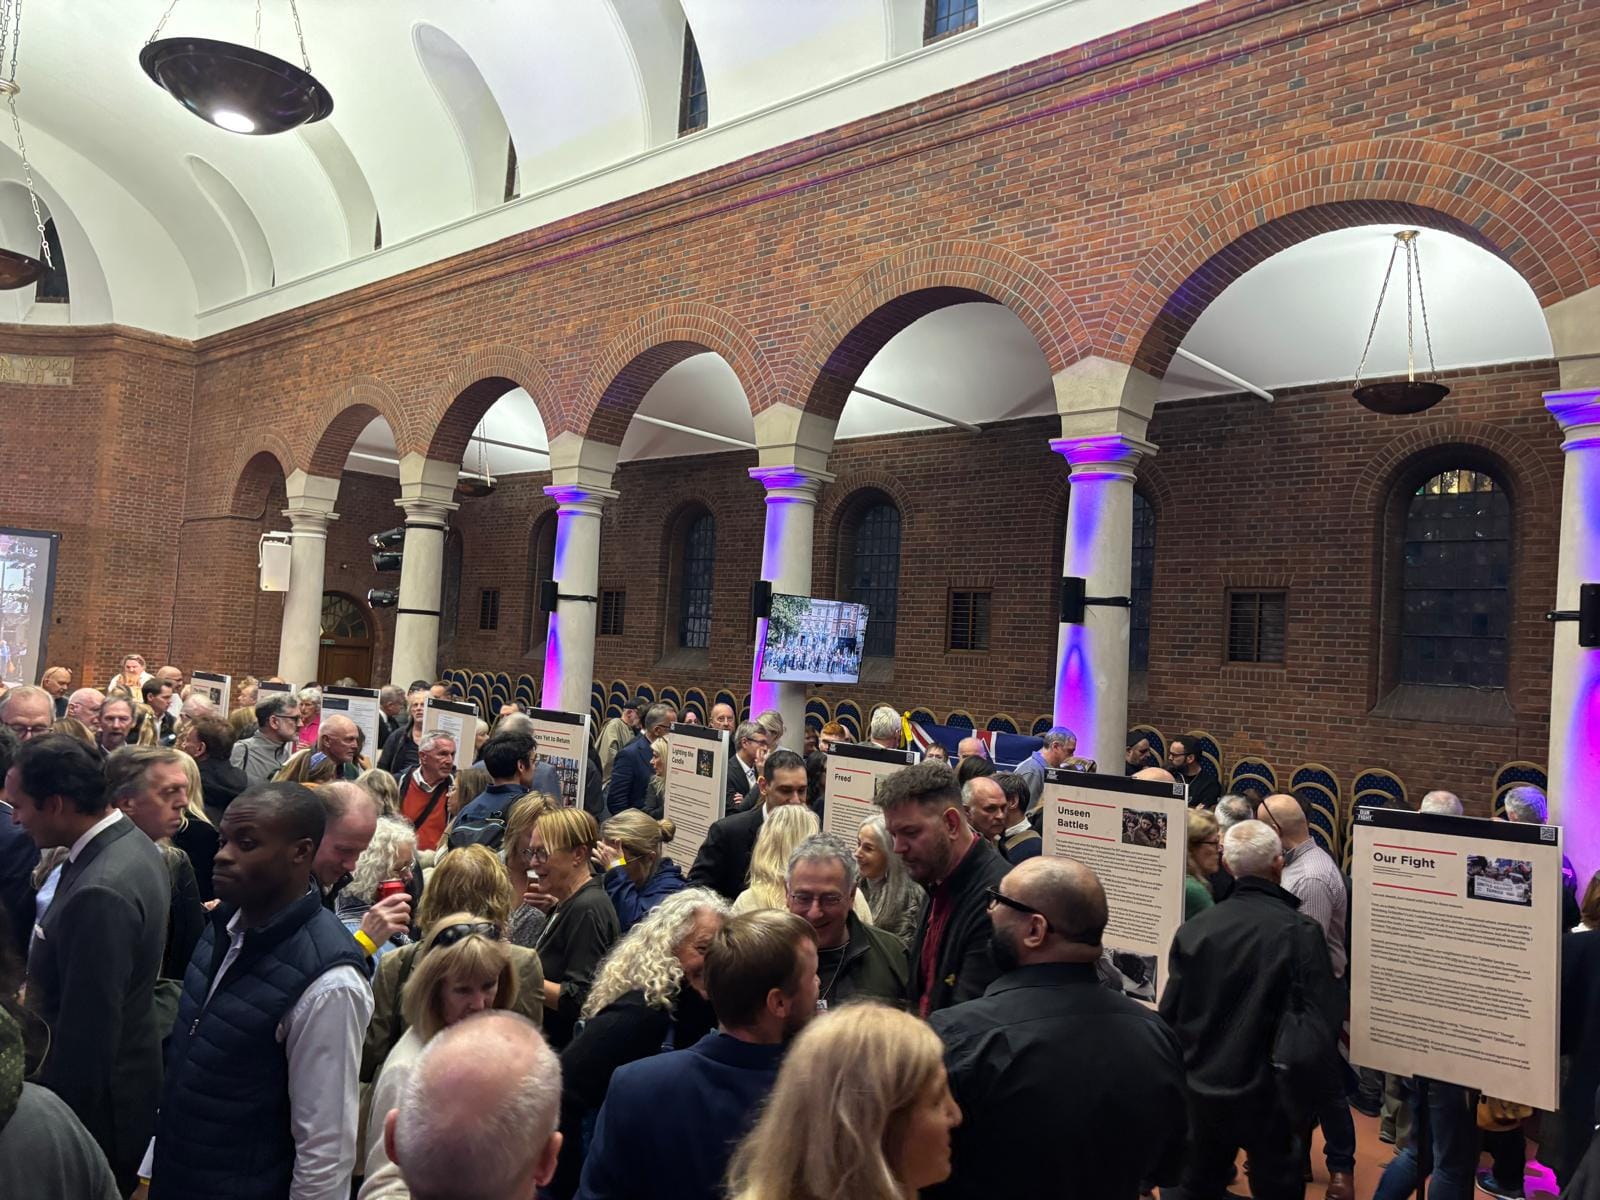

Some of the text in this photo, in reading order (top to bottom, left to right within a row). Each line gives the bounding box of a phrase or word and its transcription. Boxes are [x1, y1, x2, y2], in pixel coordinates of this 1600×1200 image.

[834, 773, 852, 782] Freed
[1057, 806, 1091, 818] Unseen
[1057, 818, 1089, 831] Battles
[1373, 852, 1436, 869] Our Fight
